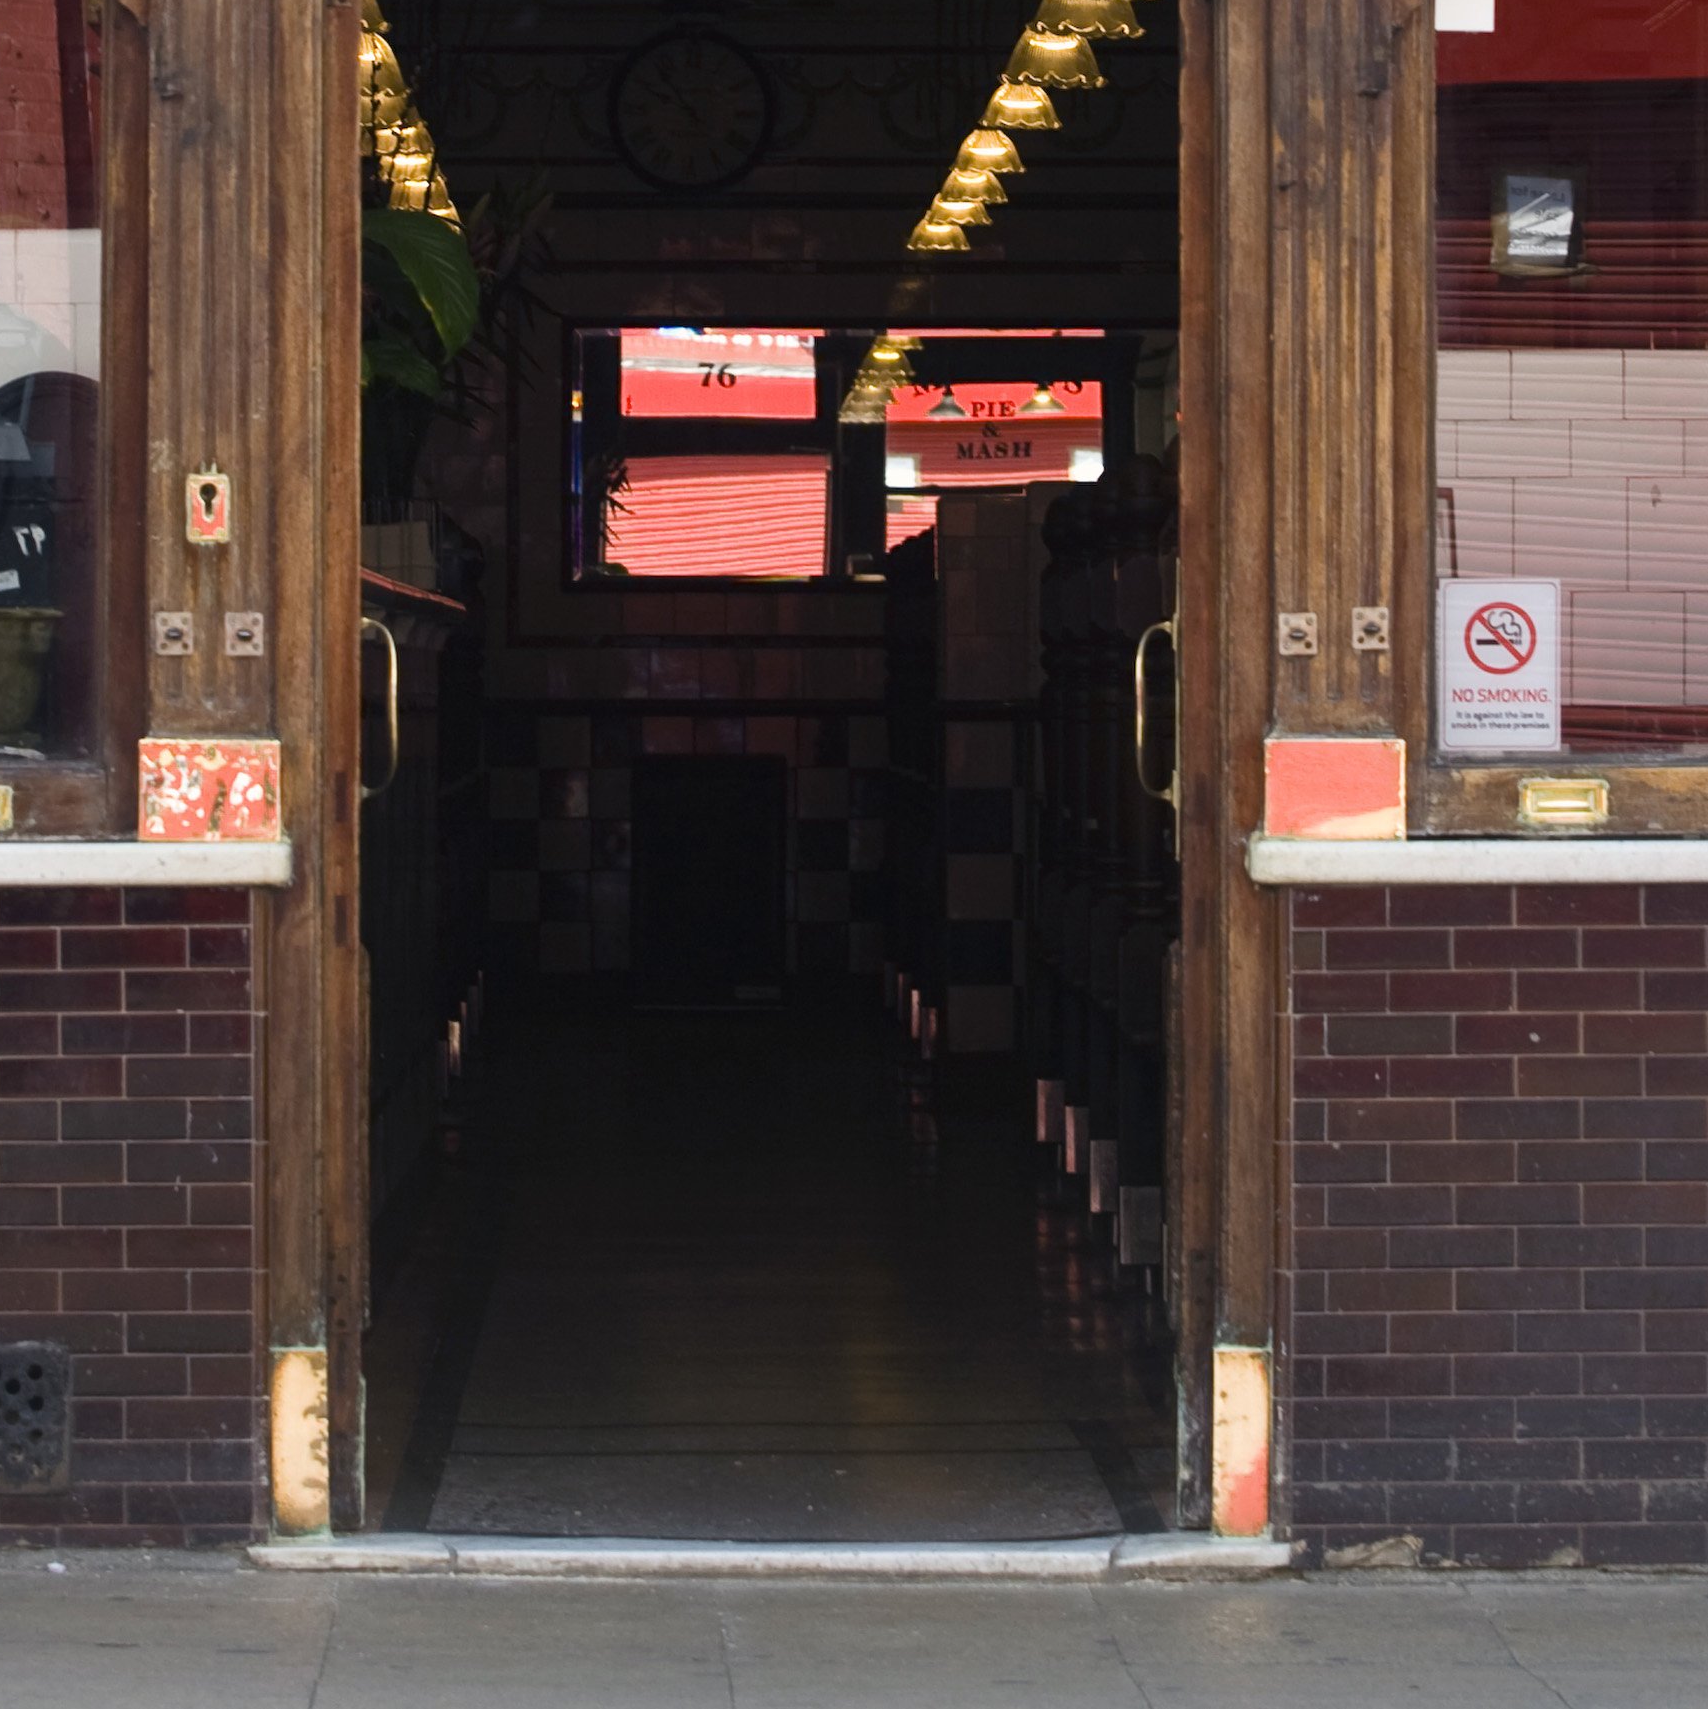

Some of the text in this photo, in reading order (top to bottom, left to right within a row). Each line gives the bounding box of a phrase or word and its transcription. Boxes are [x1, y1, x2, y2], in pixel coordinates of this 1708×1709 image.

[698, 362, 737, 388] 76
[971, 400, 1017, 418] PIE
[956, 442, 1033, 460] MASH
[1452, 688, 1474, 703] NO
